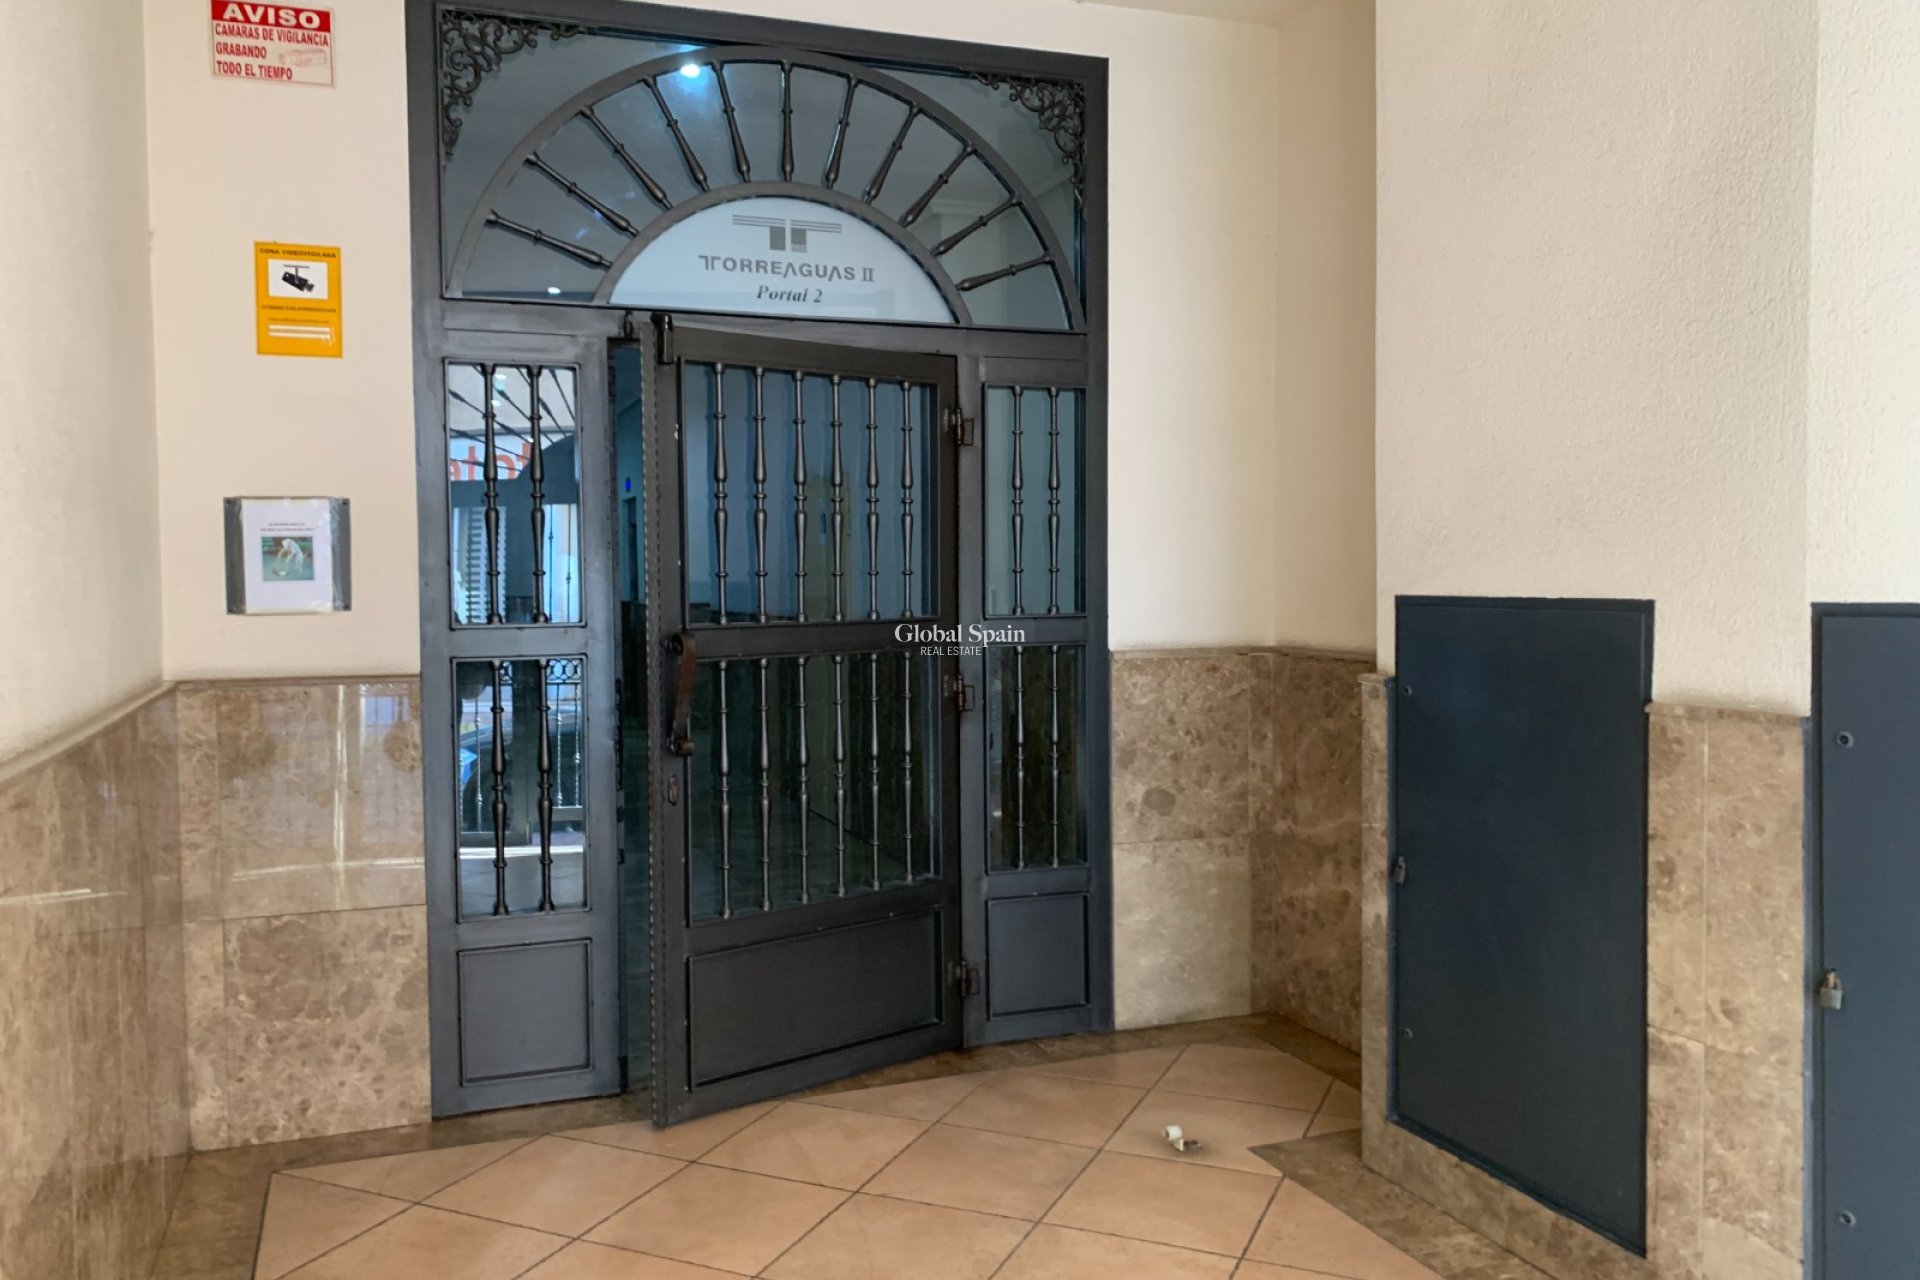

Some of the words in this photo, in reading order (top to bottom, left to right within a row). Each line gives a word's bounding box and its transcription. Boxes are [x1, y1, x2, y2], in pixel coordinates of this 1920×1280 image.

[222, 3, 321, 29] AVISO
[215, 22, 260, 41] CAMARAS
[262, 28, 275, 41] DE
[276, 29, 329, 47] VIGILANCIA
[215, 42, 267, 59] GRABANDO
[216, 60, 242, 75] TODO
[245, 63, 256, 76] EL
[258, 64, 293, 80] TIEMPO
[698, 254, 856, 282] TORREAGUAS
[860, 267, 876, 282] II
[756, 284, 809, 303] Portal
[813, 289, 823, 304] 2
